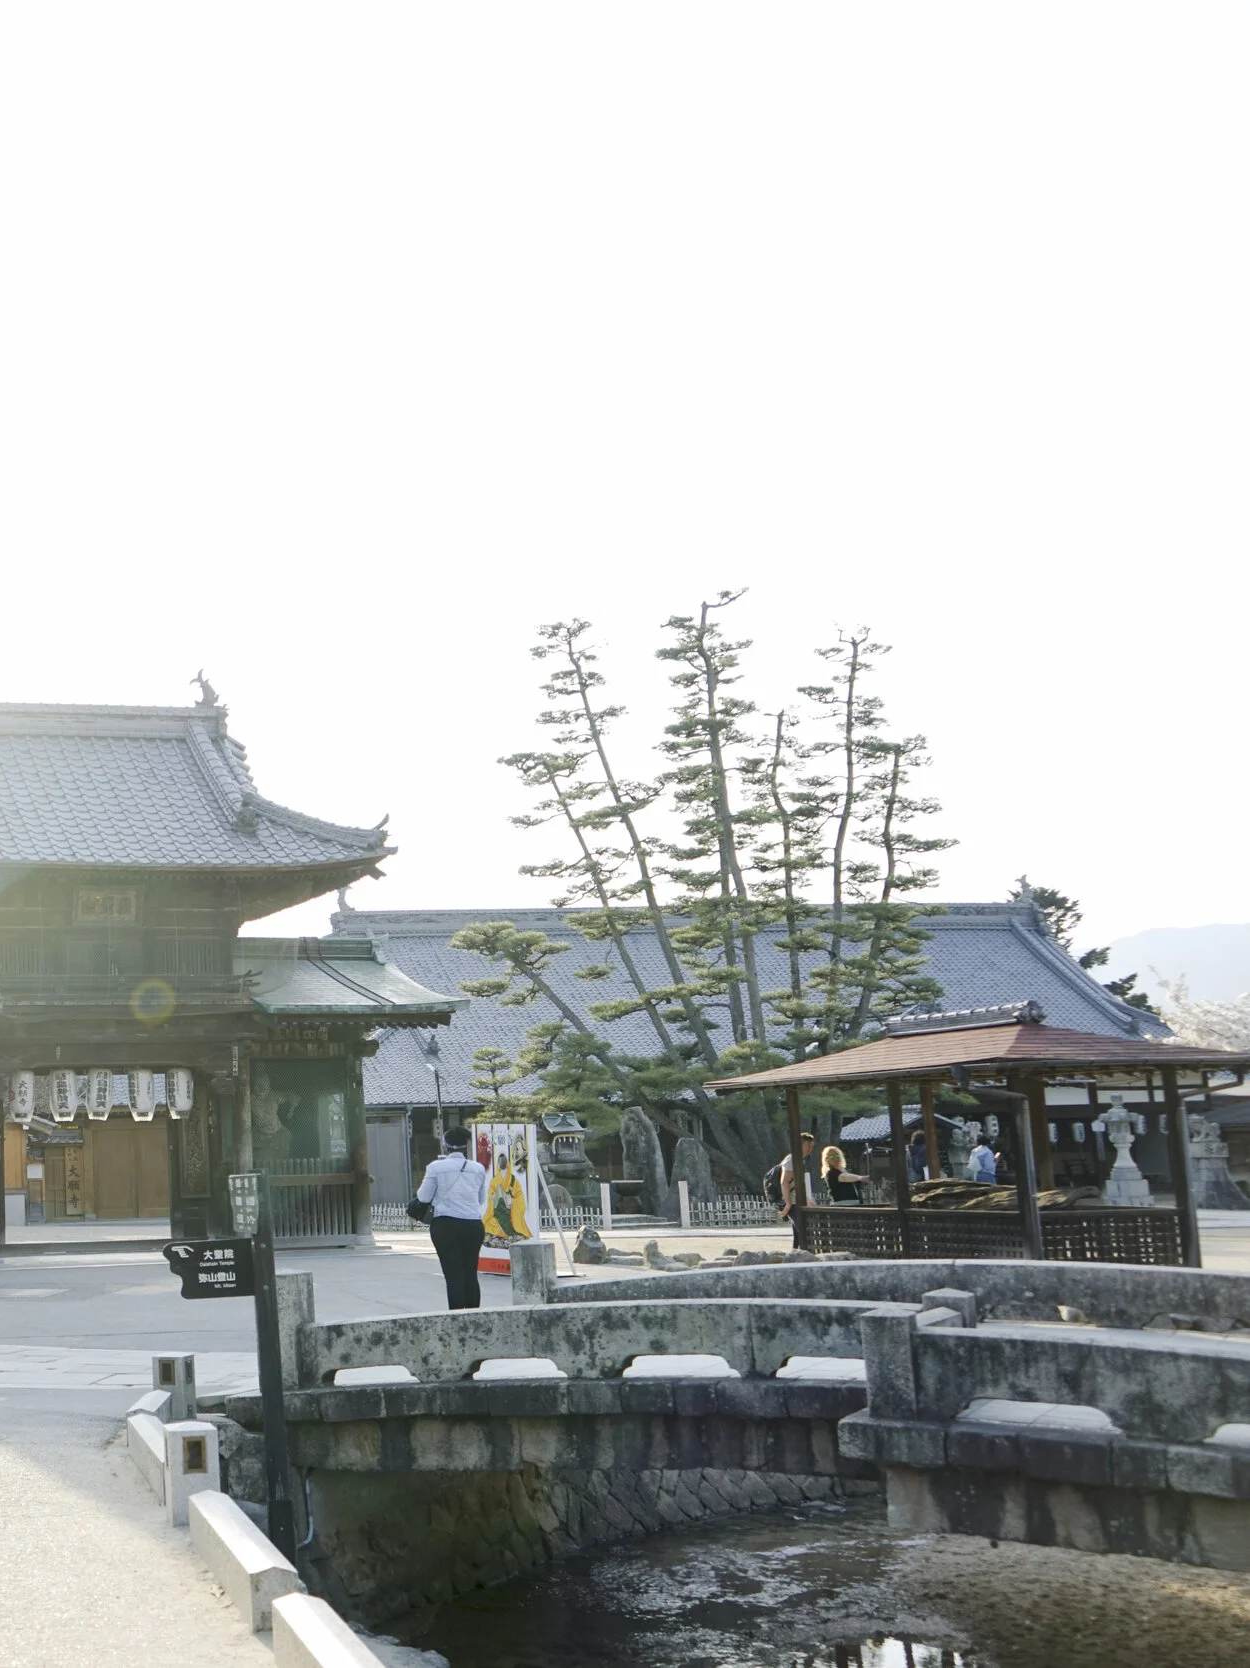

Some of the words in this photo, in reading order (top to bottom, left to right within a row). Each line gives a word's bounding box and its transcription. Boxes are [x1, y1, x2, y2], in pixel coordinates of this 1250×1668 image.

[203, 1249, 234, 1260] 大聖院
[198, 1271, 236, 1283] 弥山登山
